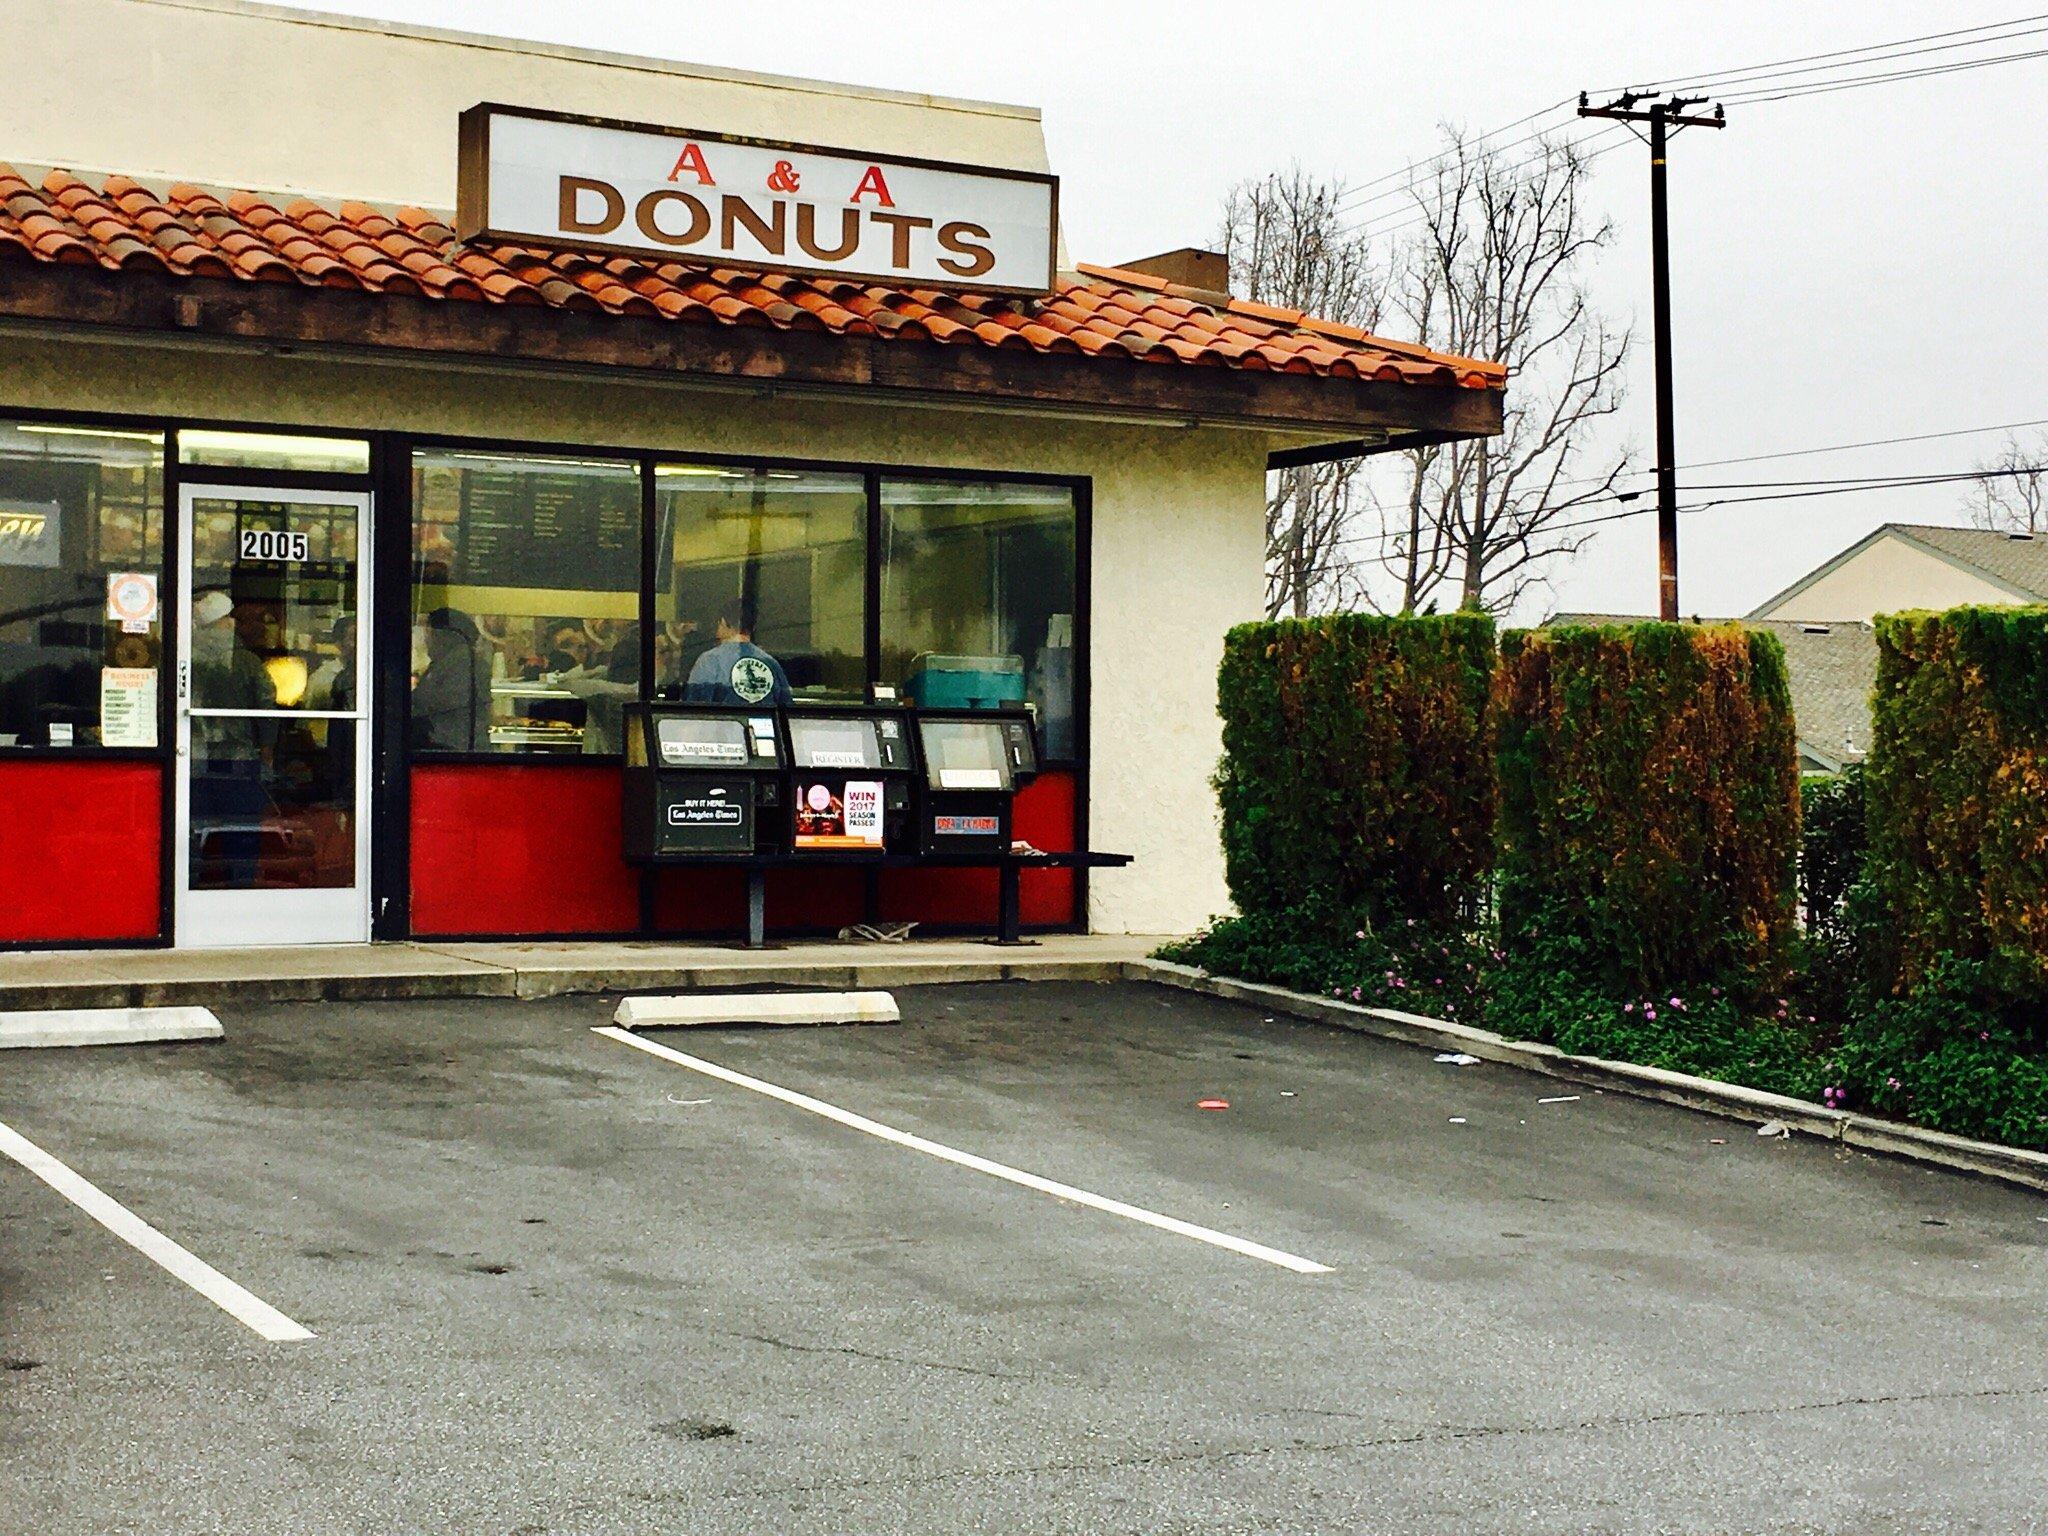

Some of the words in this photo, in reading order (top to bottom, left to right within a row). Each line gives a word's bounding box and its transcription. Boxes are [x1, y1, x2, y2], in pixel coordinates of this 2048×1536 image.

[668, 143, 715, 187] A
[767, 159, 801, 193] &
[850, 165, 895, 208] A
[557, 174, 997, 278] DONUTS
[243, 531, 305, 560] 2005
[663, 743, 679, 753] Los
[681, 743, 715, 756] Angeles
[717, 744, 744, 754] Times
[849, 792, 876, 801] WIN
[849, 802, 875, 811] 2017
[687, 810, 714, 821] Angeles
[849, 811, 876, 819] SEASON
